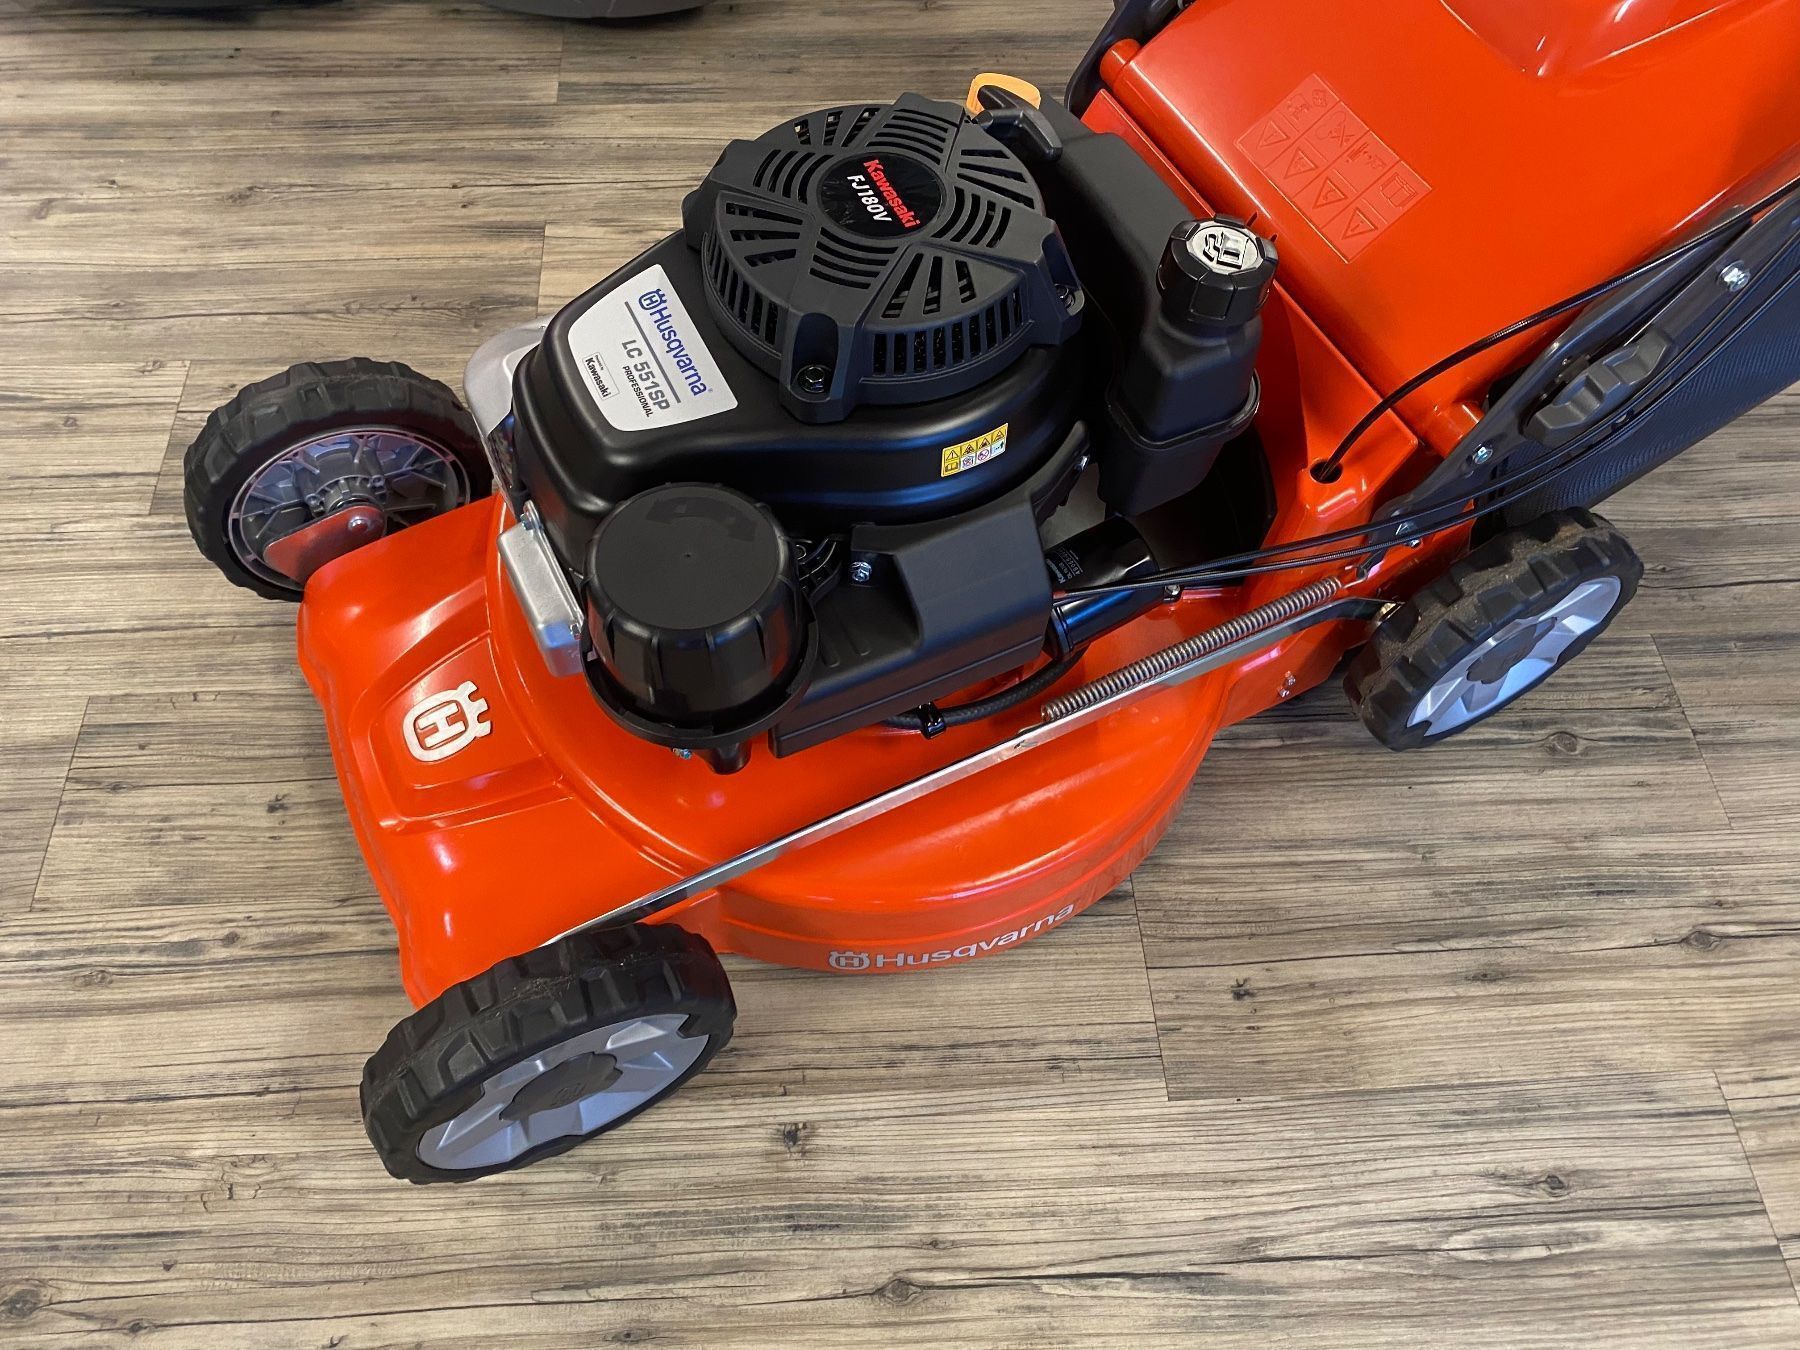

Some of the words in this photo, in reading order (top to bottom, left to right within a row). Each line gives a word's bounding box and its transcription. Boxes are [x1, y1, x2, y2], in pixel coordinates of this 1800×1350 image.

[846, 174, 892, 221] FJ180V
[863, 159, 921, 228] Kawasaki
[585, 357, 612, 398] Kawasaki
[621, 339, 643, 359] LC
[633, 360, 671, 410] 551SP
[650, 306, 707, 396] Husqvarna
[622, 365, 654, 417] PROFESSIONAL
[876, 903, 1074, 968] Husqvarna
